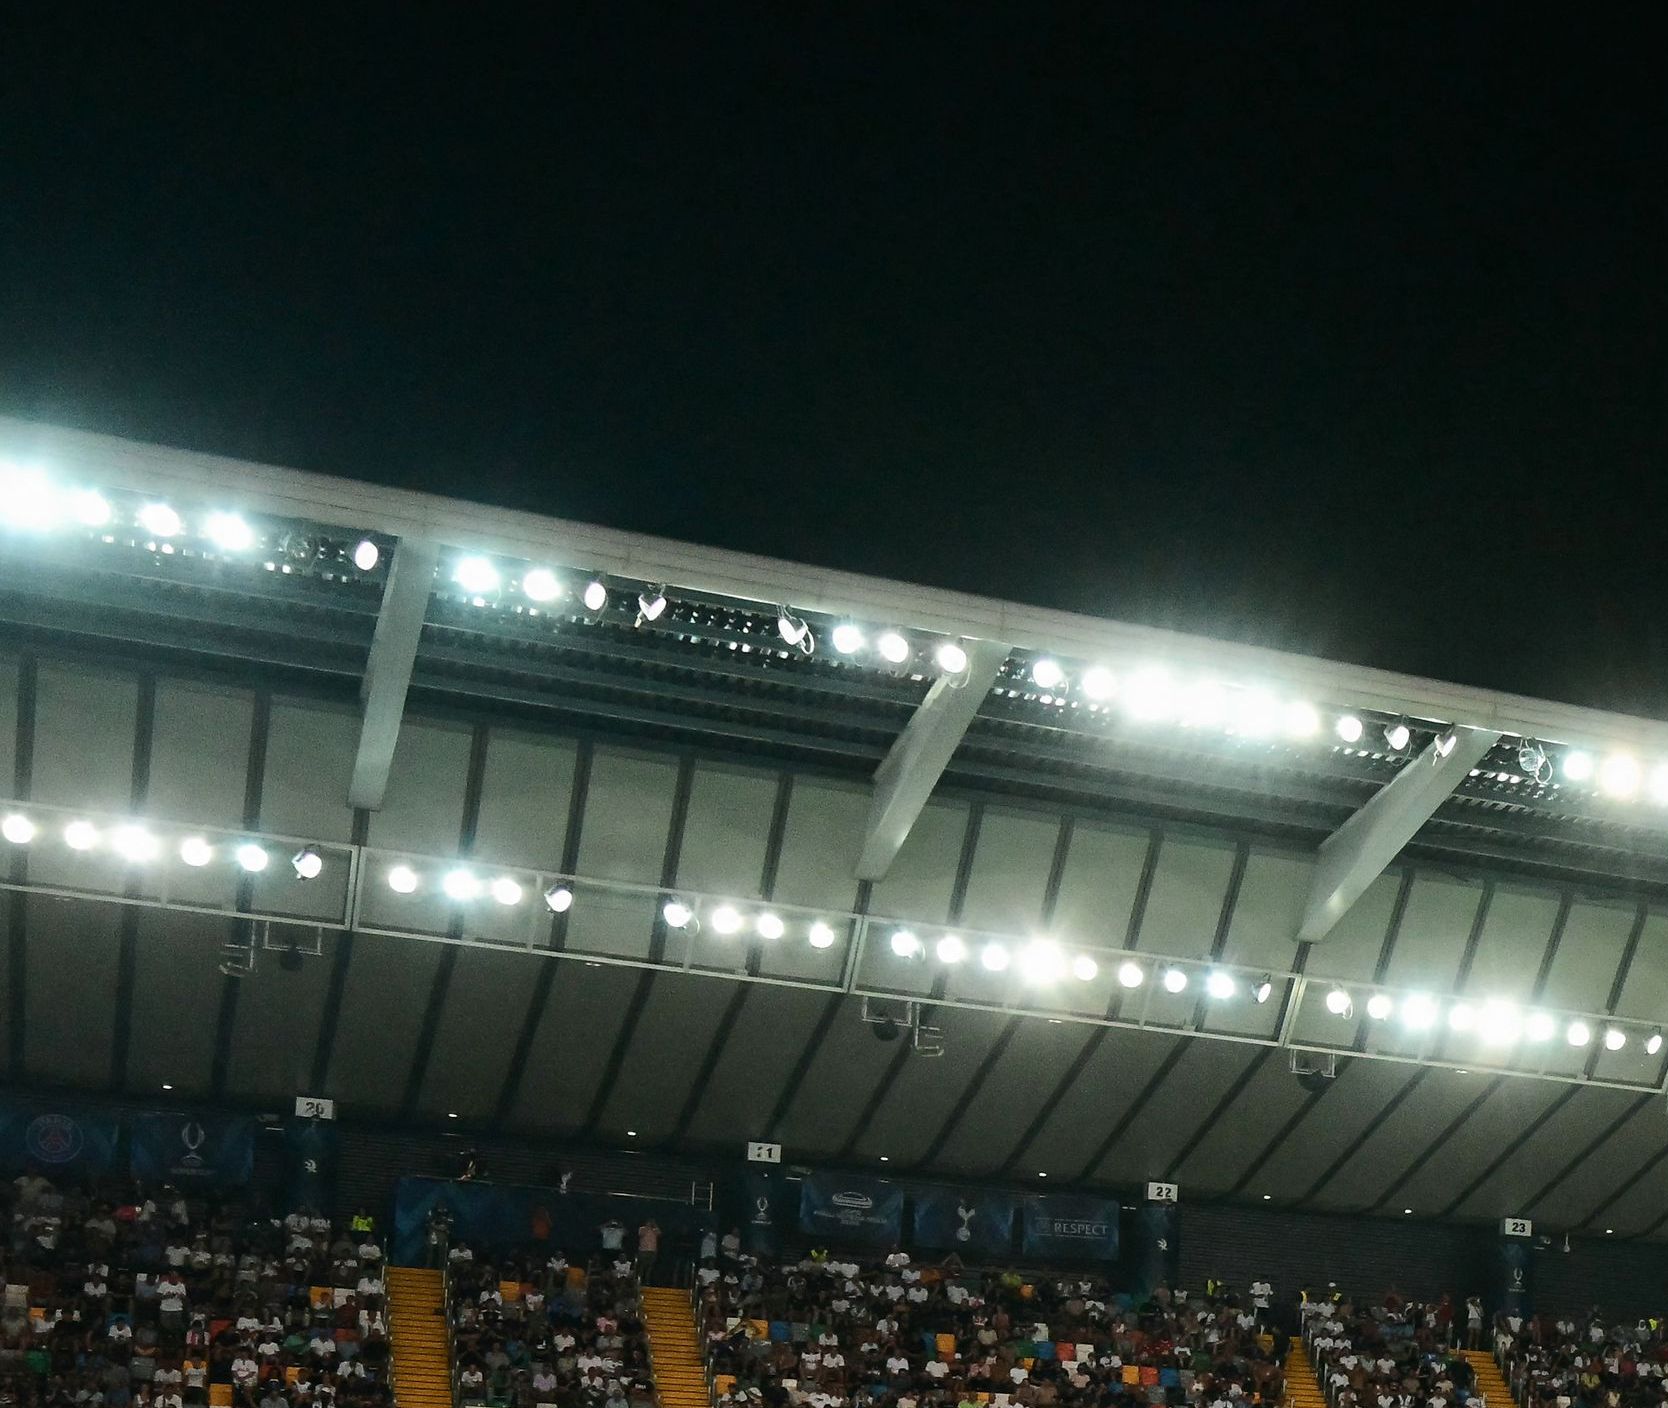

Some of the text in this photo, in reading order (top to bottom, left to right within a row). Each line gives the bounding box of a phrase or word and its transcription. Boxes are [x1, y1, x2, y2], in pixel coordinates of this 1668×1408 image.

[1156, 1186, 1172, 1198] 22
[1054, 1222, 1108, 1236] RESPECT
[1511, 1222, 1526, 1233] 23
